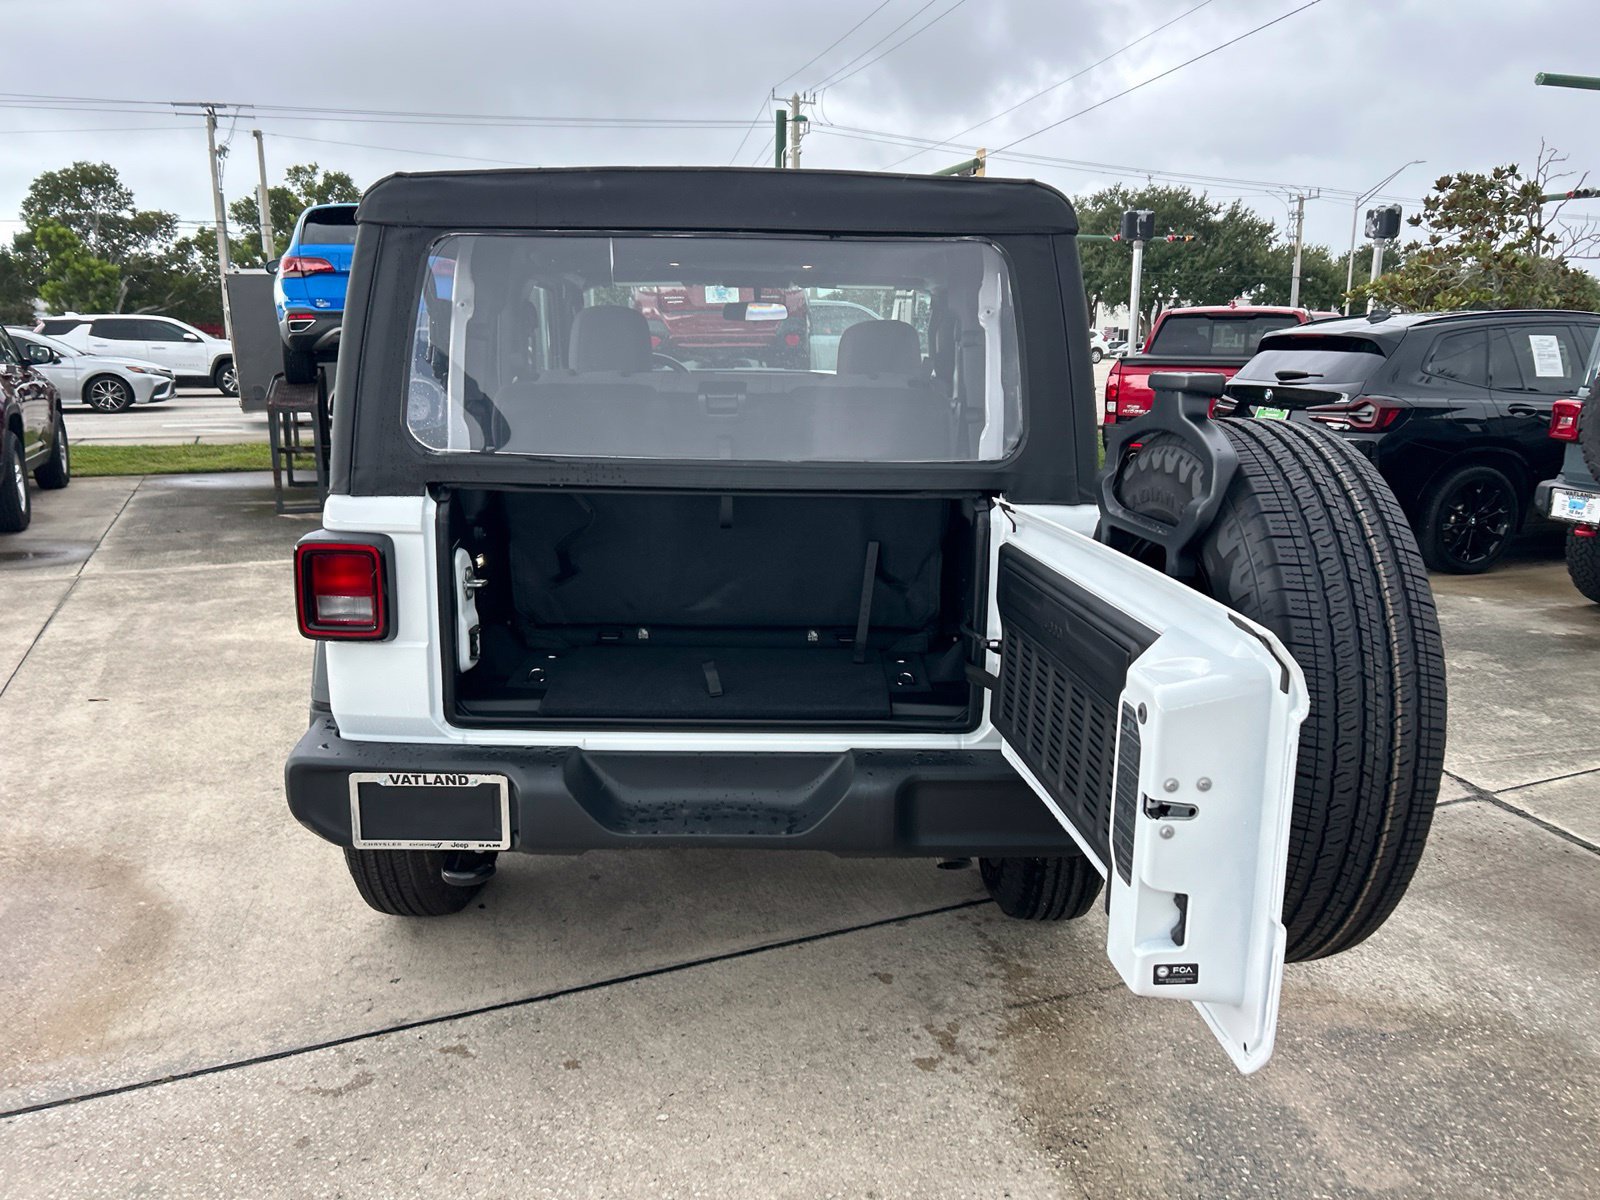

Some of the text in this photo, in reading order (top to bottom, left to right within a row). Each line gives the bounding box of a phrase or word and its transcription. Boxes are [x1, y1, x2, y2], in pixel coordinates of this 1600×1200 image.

[388, 774, 470, 786] VATLAND
[450, 841, 469, 849] Jeep
[1172, 966, 1193, 974] FCA
